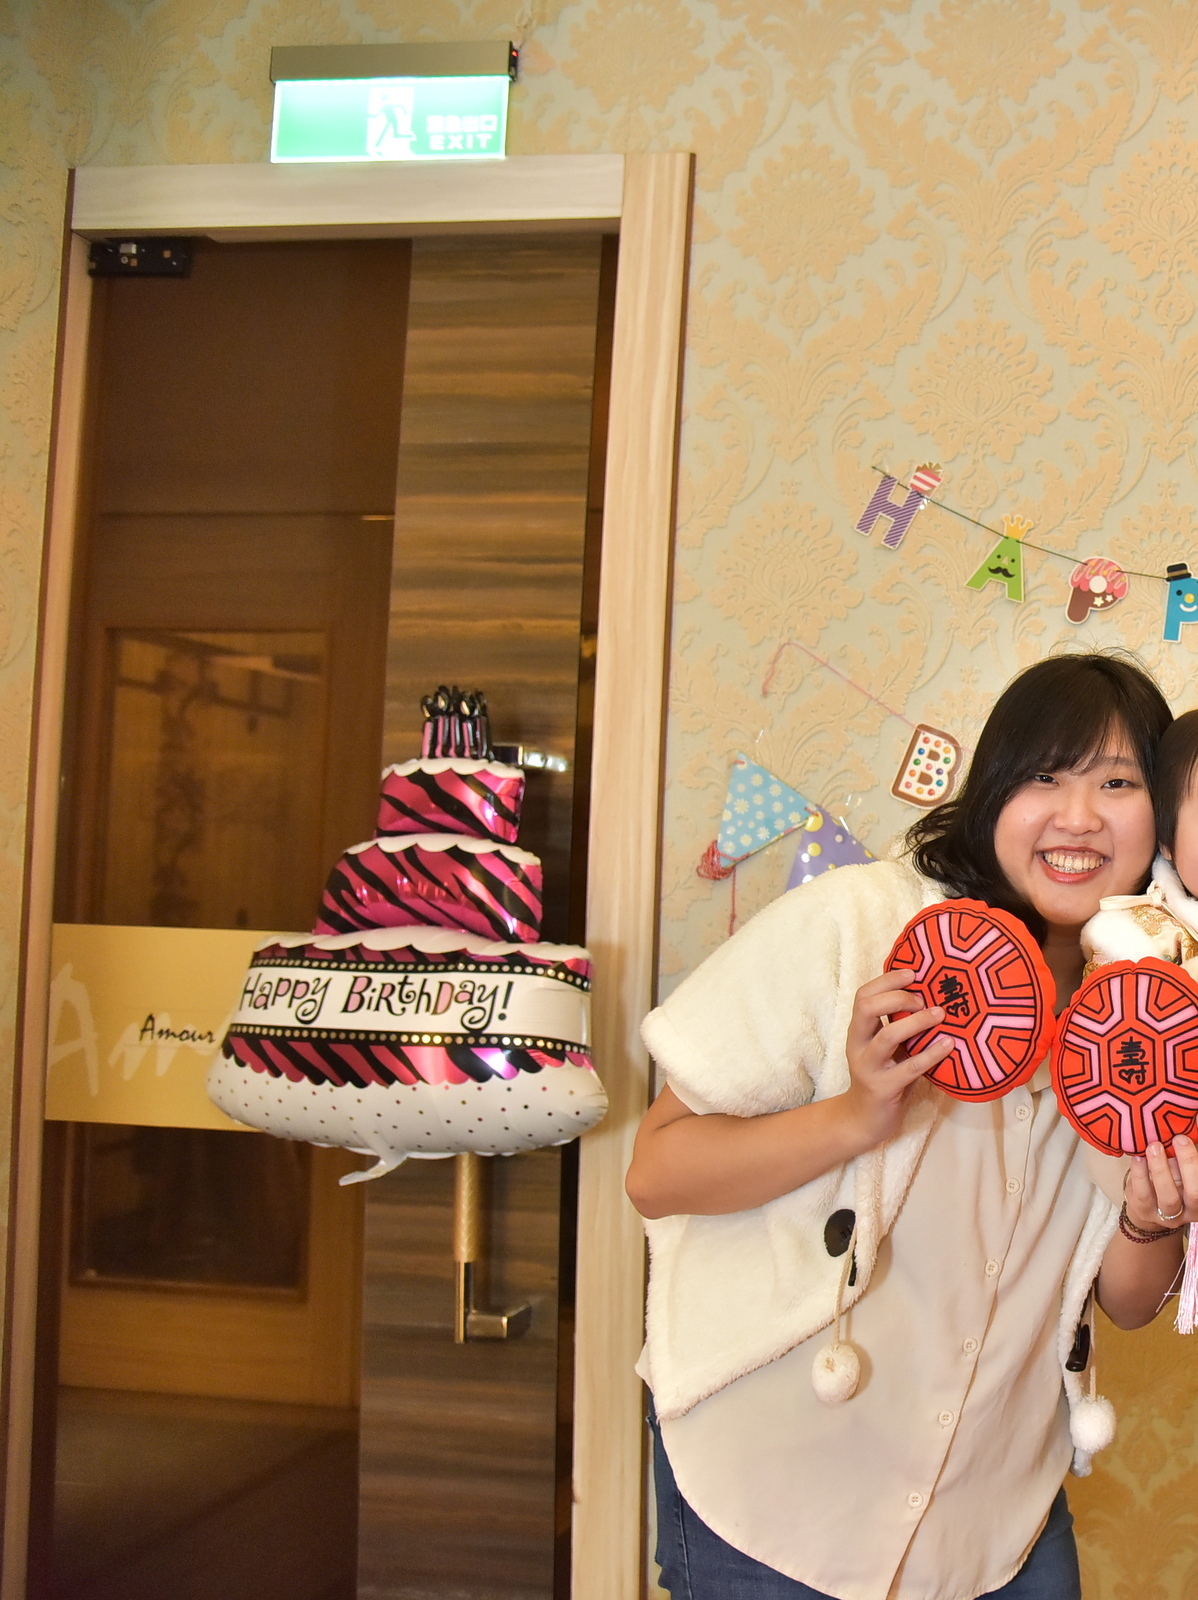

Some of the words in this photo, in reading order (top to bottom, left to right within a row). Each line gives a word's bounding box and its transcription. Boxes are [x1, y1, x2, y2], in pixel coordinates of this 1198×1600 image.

[430, 134, 492, 150] EXIT
[239, 973, 332, 1024] Happy
[138, 1011, 217, 1045] Amour
